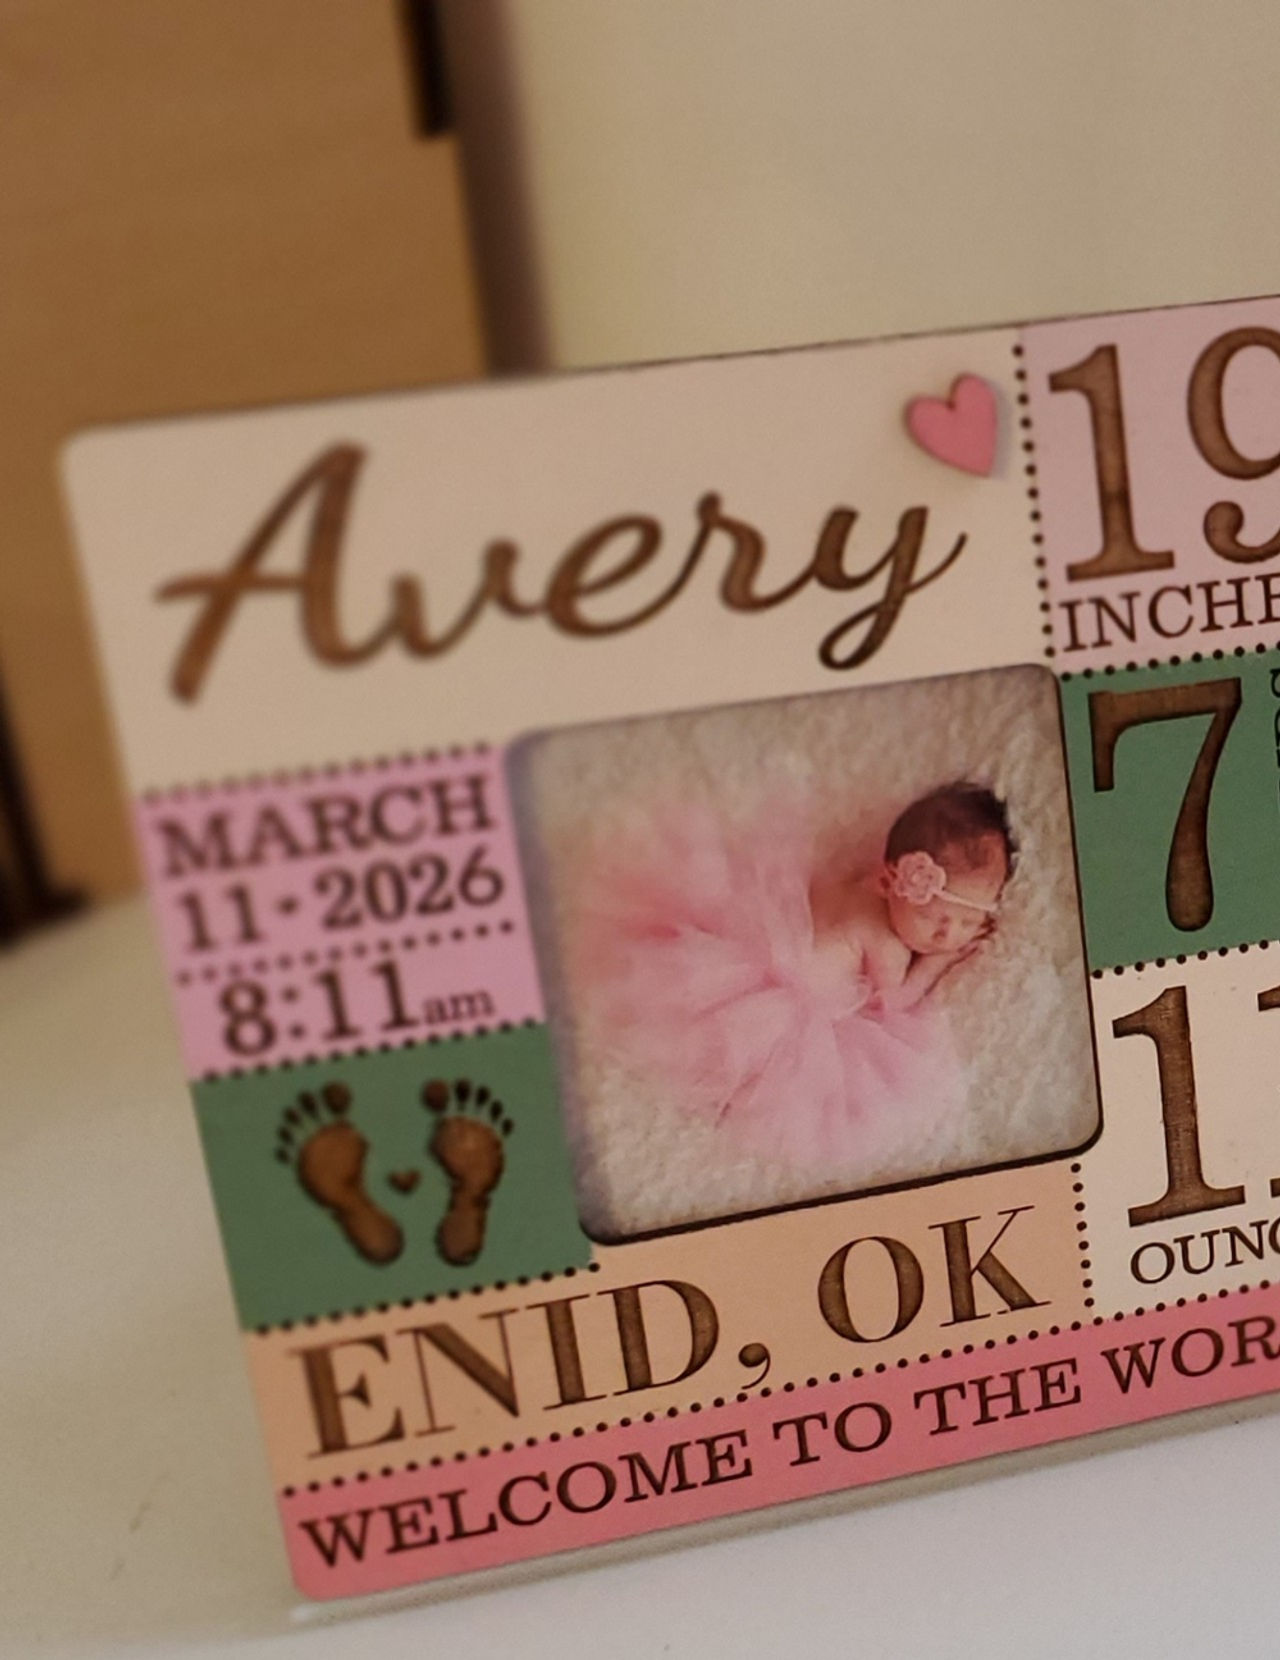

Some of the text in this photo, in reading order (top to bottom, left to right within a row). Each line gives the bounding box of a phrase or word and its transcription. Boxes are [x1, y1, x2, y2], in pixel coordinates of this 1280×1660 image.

[154, 439, 969, 707] Avery
[157, 774, 493, 879] MARCH
[1088, 677, 1243, 932] 7
[286, 1204, 1053, 1460] ENID, OK
[299, 1429, 753, 1569] WELCOME
[772, 1402, 893, 1468] TO
[914, 1357, 1083, 1437] THE
